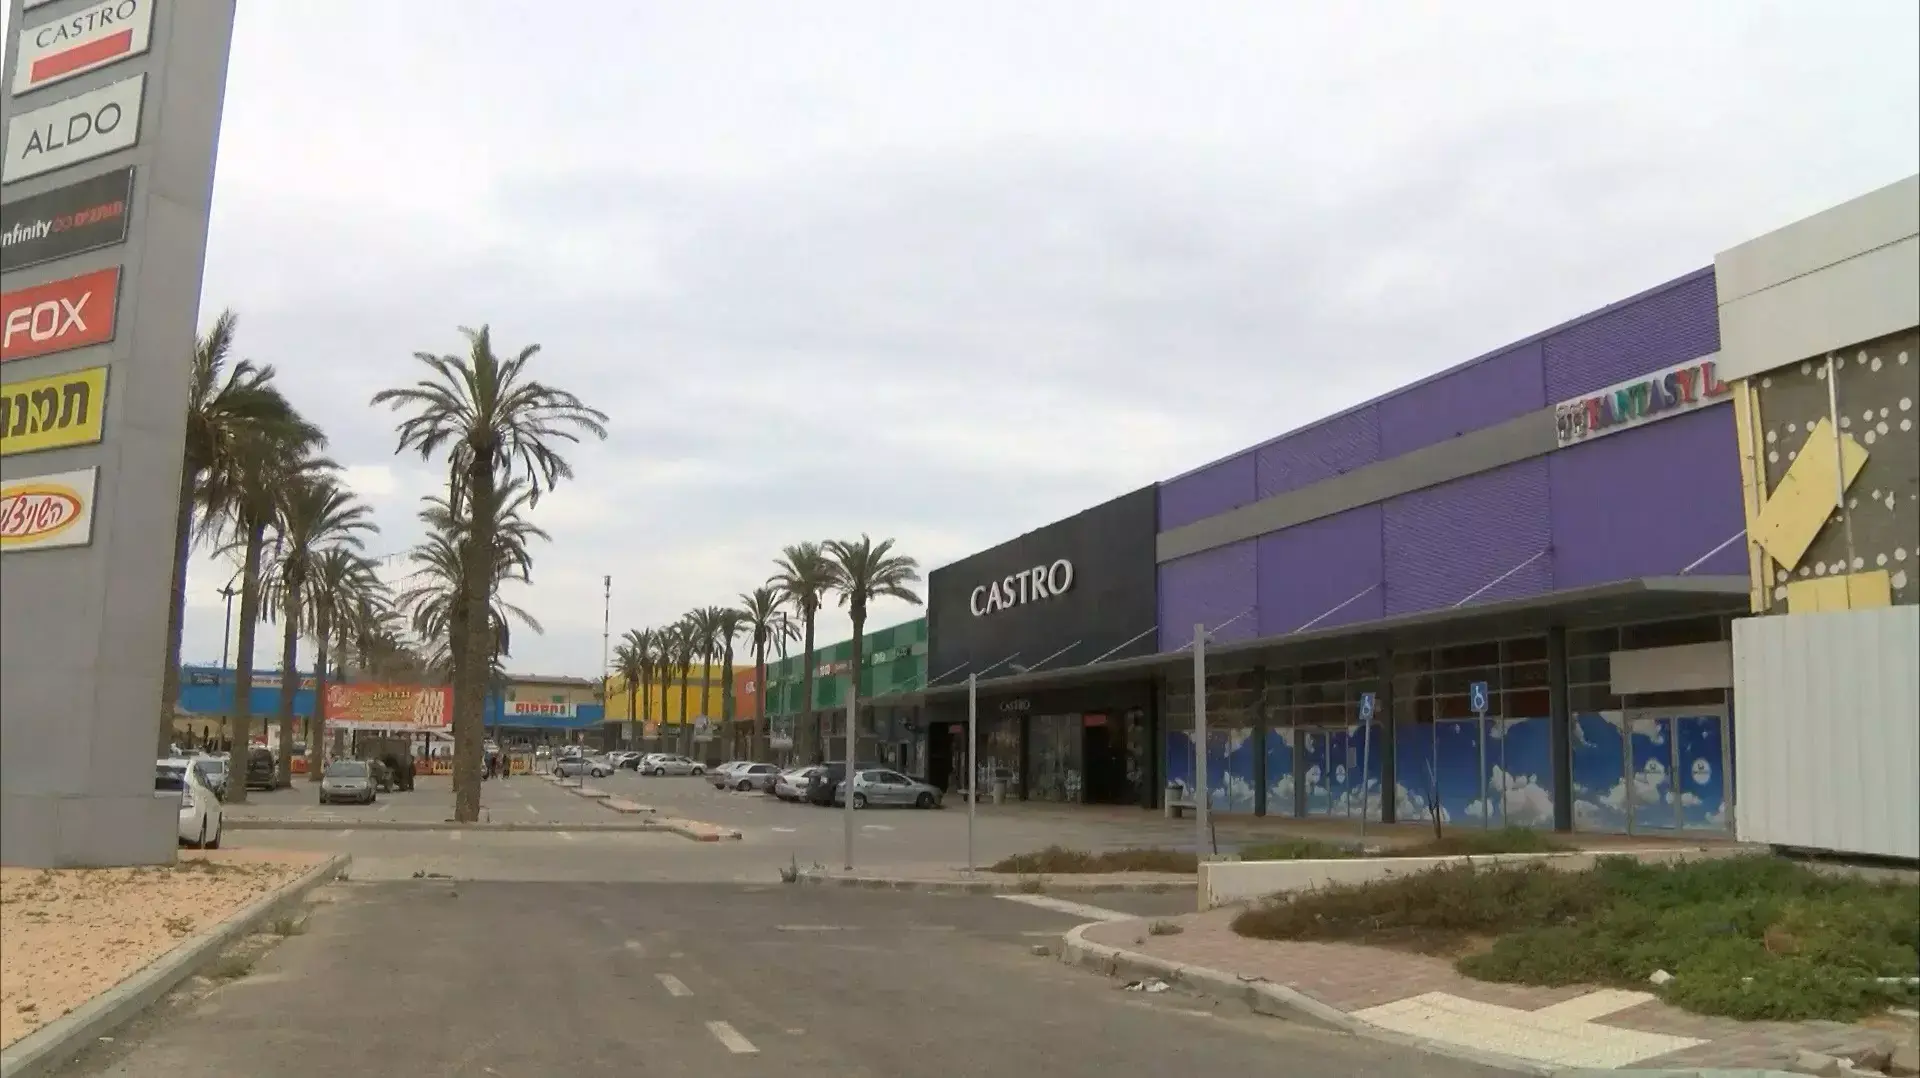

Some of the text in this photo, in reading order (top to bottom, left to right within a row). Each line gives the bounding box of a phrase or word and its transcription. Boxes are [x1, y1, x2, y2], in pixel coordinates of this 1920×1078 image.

[36, 0, 137, 48] CASTRO
[21, 102, 122, 160] ALDO
[3, 291, 92, 348] FOX
[1586, 366, 1700, 431] FANTASY
[970, 558, 1074, 617] CASTRO
